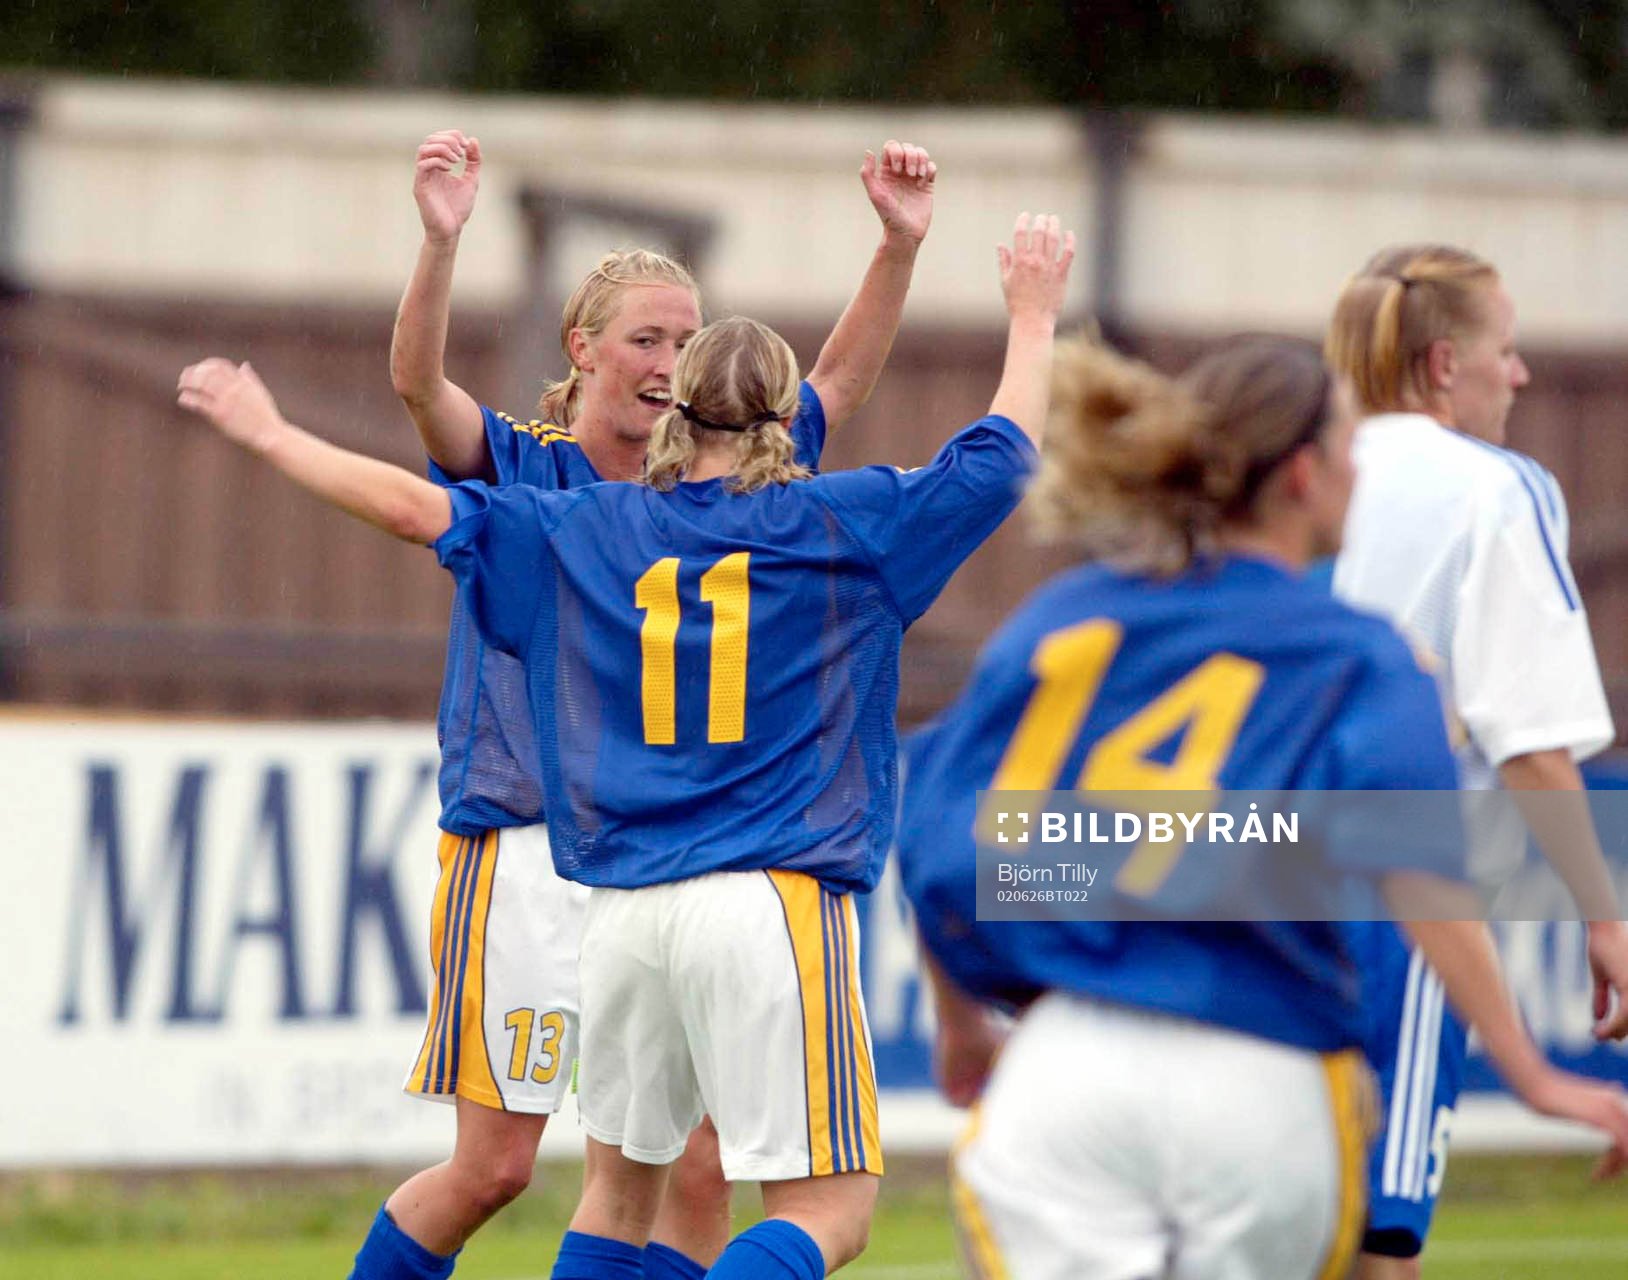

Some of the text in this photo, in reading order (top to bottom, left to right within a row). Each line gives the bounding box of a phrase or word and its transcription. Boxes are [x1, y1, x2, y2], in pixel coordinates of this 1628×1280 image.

[635, 552, 750, 744] 11
[974, 617, 1266, 897] 14
[504, 1007, 564, 1084] 13
